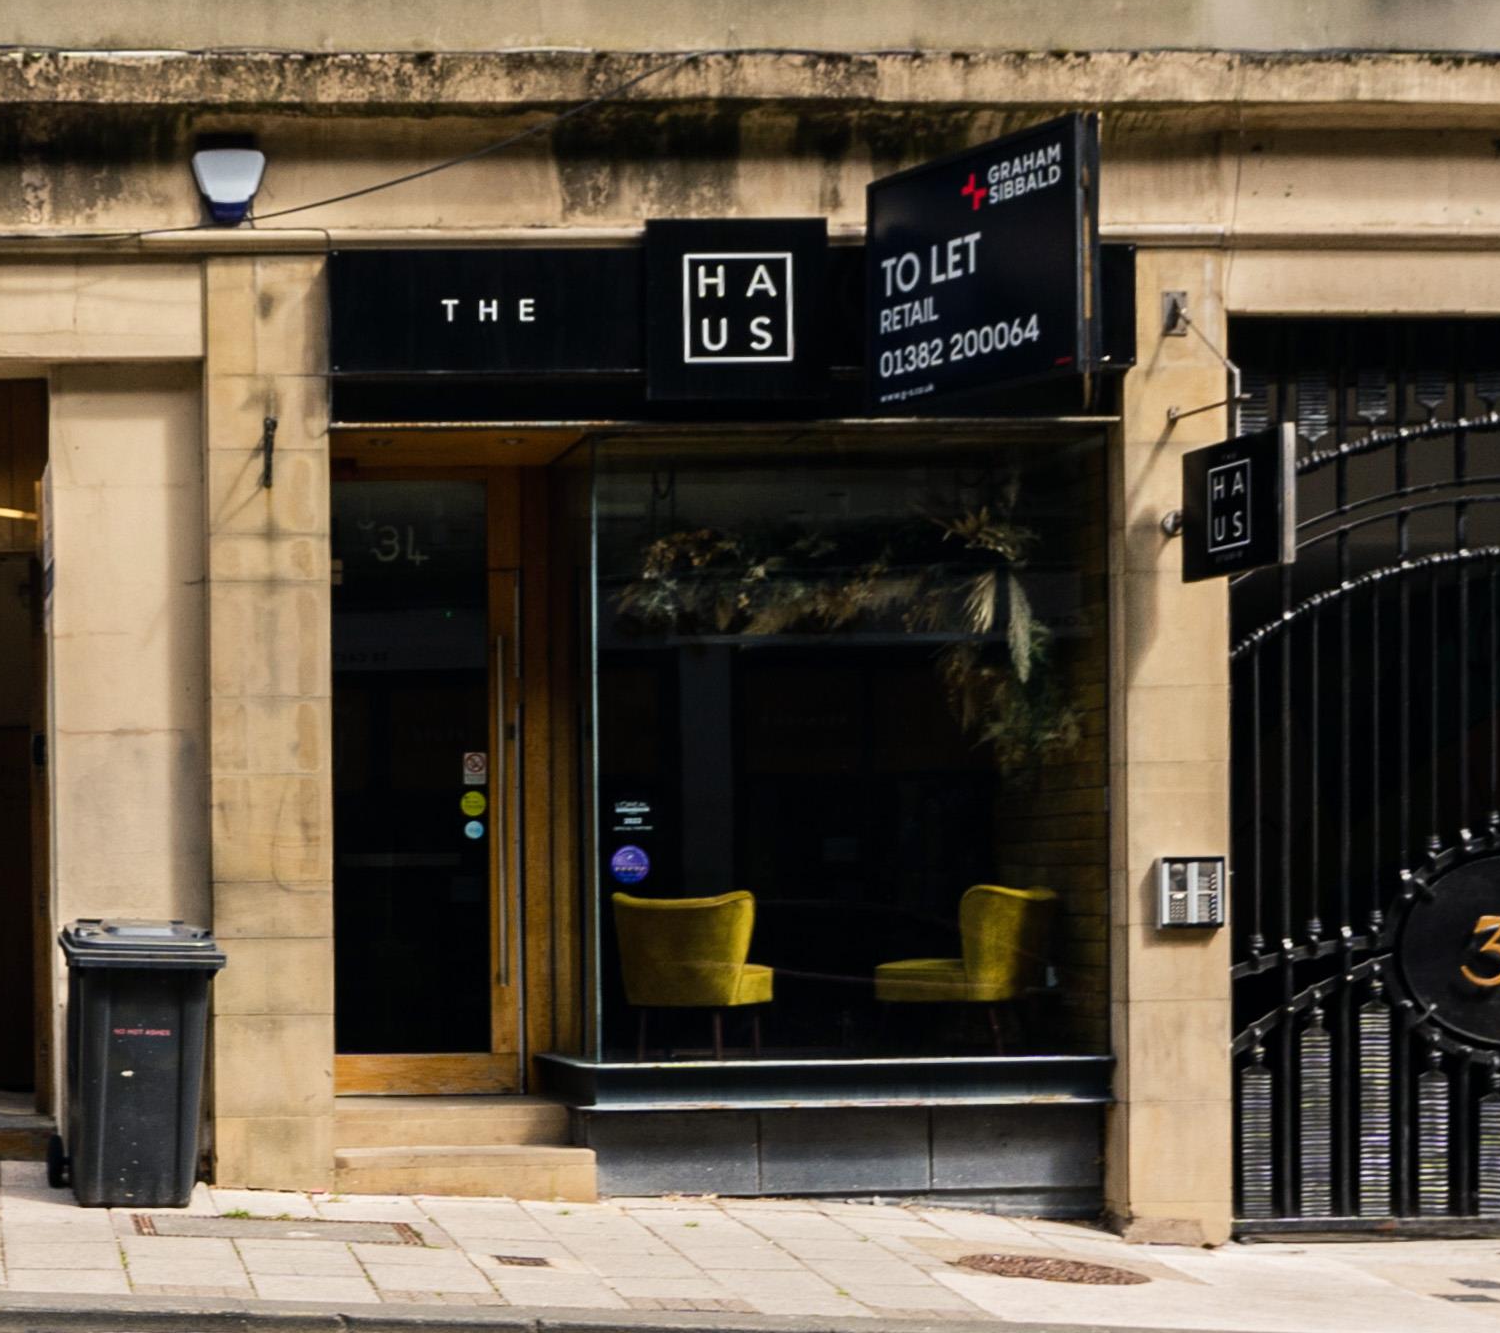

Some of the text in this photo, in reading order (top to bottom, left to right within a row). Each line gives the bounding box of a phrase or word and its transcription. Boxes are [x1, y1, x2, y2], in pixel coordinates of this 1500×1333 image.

[987, 142, 1062, 184] GRAHAM
[988, 165, 1062, 204] SIBBALD
[881, 231, 981, 298] TO LET
[441, 298, 536, 322] THE
[880, 296, 940, 334] RETAIL
[880, 313, 1040, 378] 01382 200064
[369, 525, 432, 566] 34
